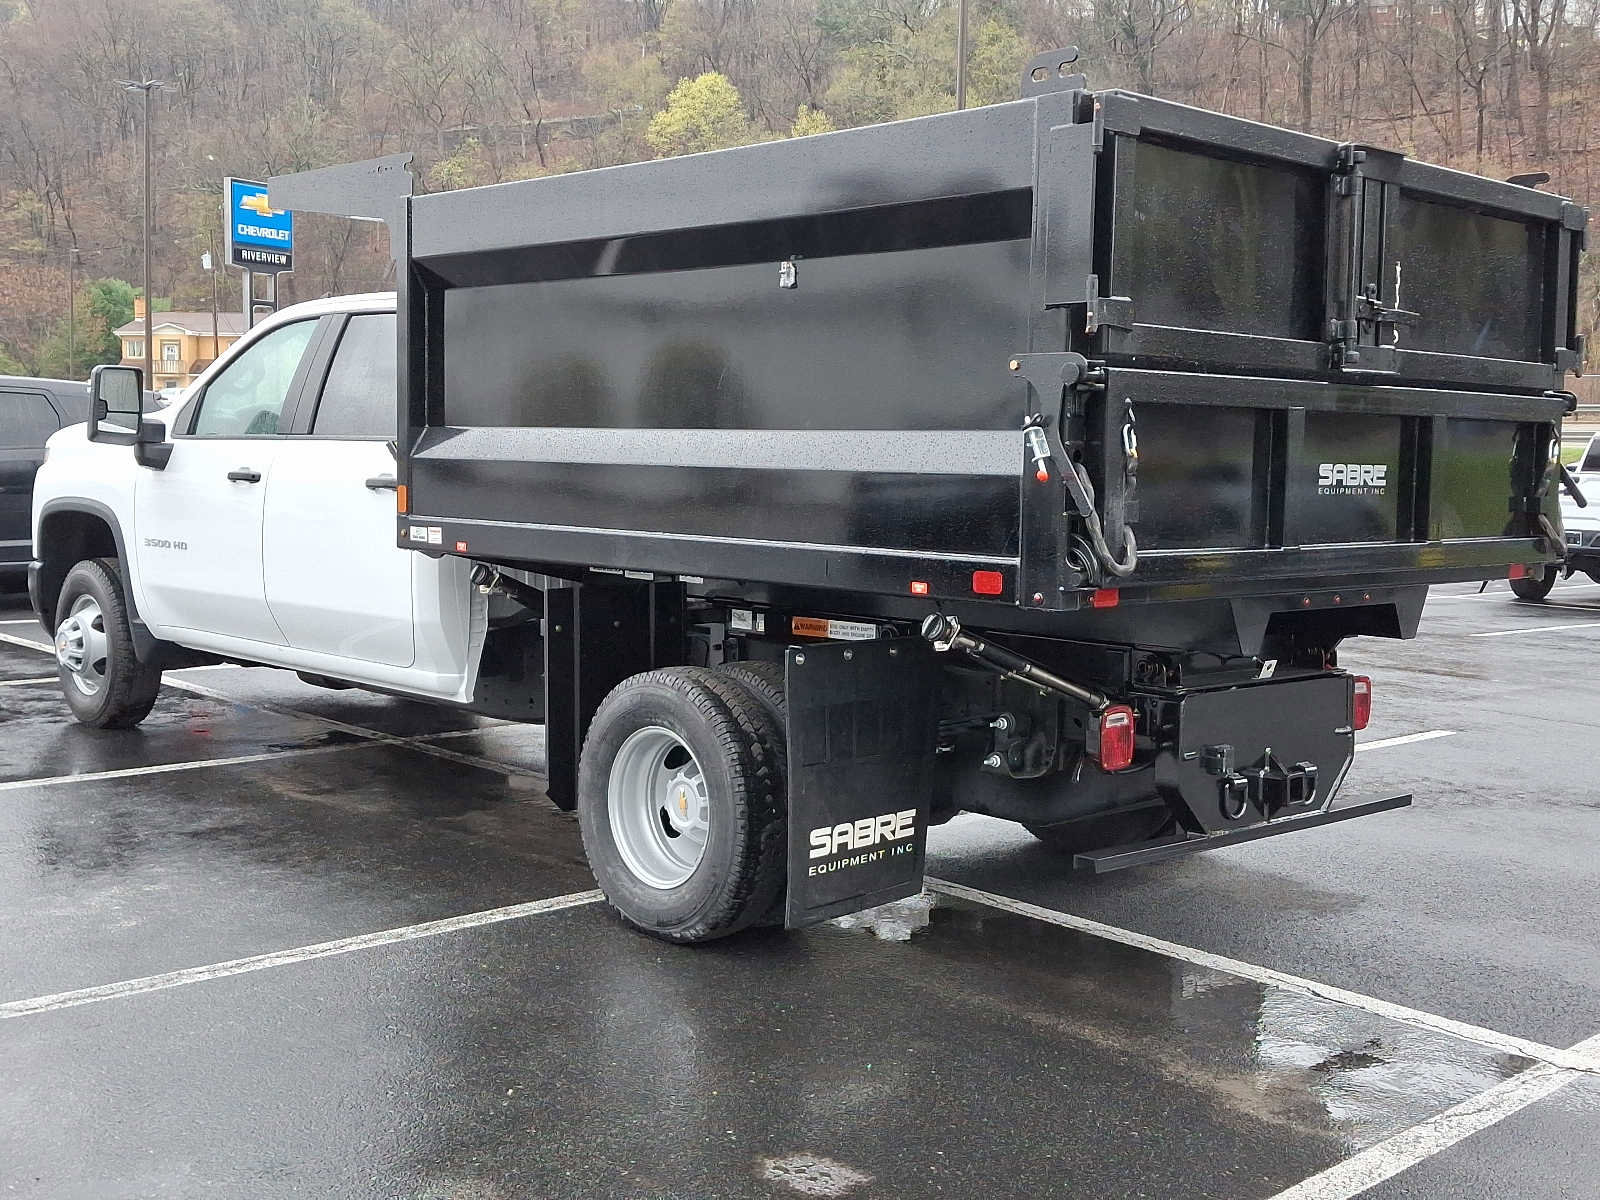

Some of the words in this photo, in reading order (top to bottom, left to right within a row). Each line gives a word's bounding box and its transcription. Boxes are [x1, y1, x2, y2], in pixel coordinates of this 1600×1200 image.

[237, 223, 290, 241] CHEVROLET
[241, 249, 287, 265] RIVERVIEW
[1318, 463, 1387, 486] SABRE
[1318, 487, 1369, 495] EQUIPMENT
[1371, 487, 1385, 495] INC
[144, 537, 171, 549] 3500
[173, 541, 188, 550] HD
[809, 808, 917, 859] SABRE
[808, 850, 885, 877] EQUIPMENT
[891, 843, 913, 857] INC
